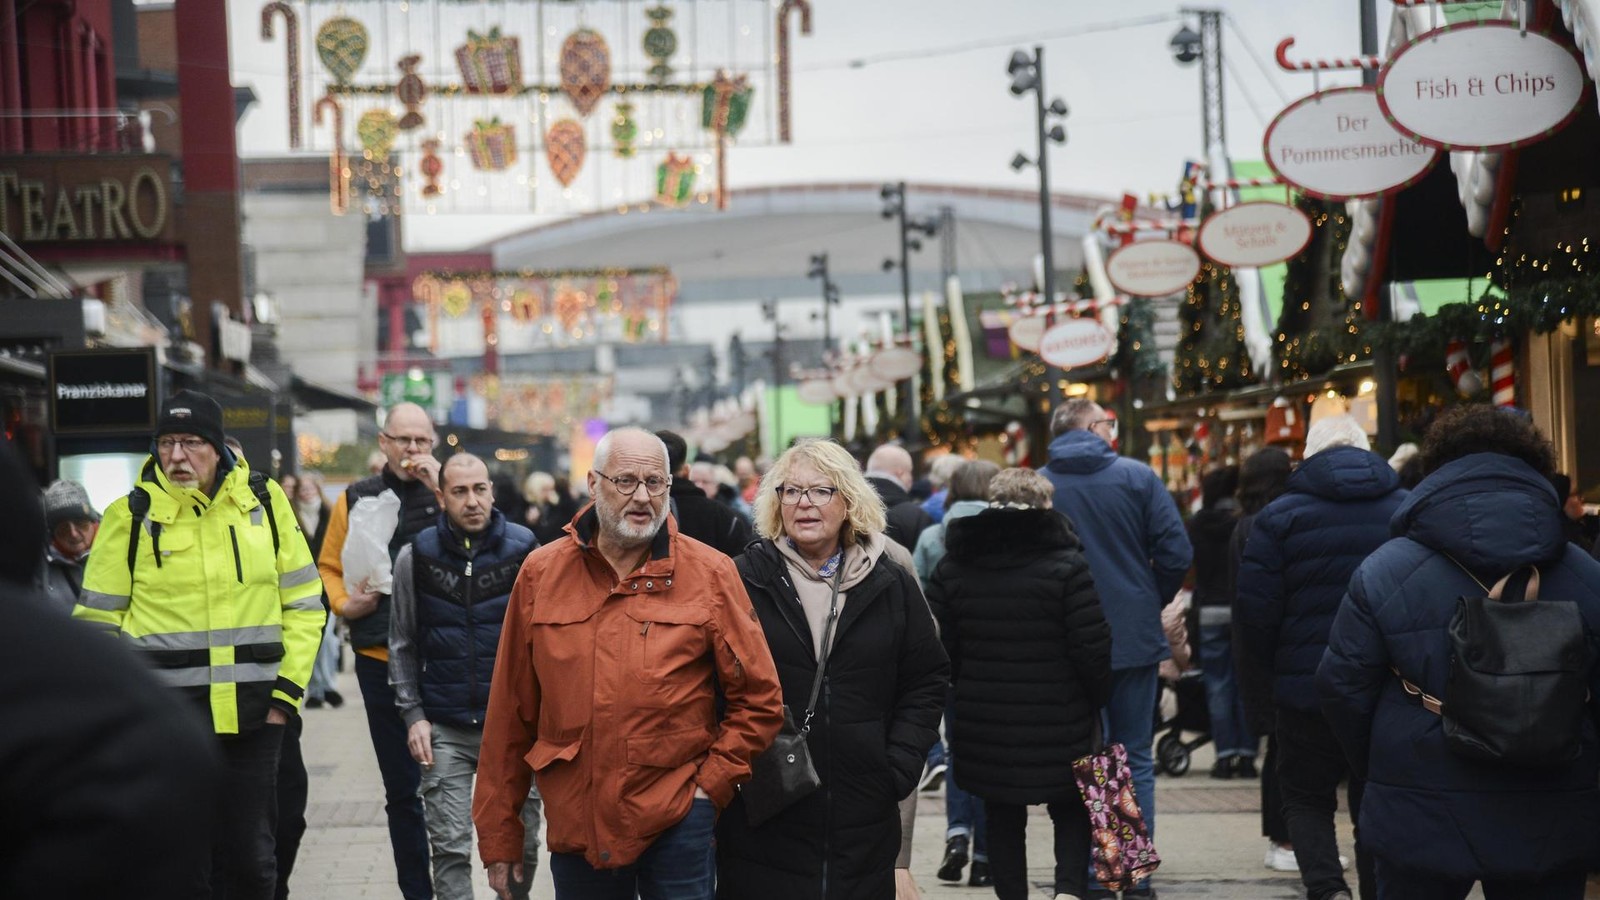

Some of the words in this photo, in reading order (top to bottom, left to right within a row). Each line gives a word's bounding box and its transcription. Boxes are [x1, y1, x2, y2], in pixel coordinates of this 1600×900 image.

[1415, 77, 1458, 100] Fish
[1468, 77, 1485, 97] &
[1494, 71, 1556, 97] Chips
[1336, 115, 1369, 133] Der
[1281, 138, 1429, 165] Pommesmacher
[57, 382, 147, 399] Franziskaner
